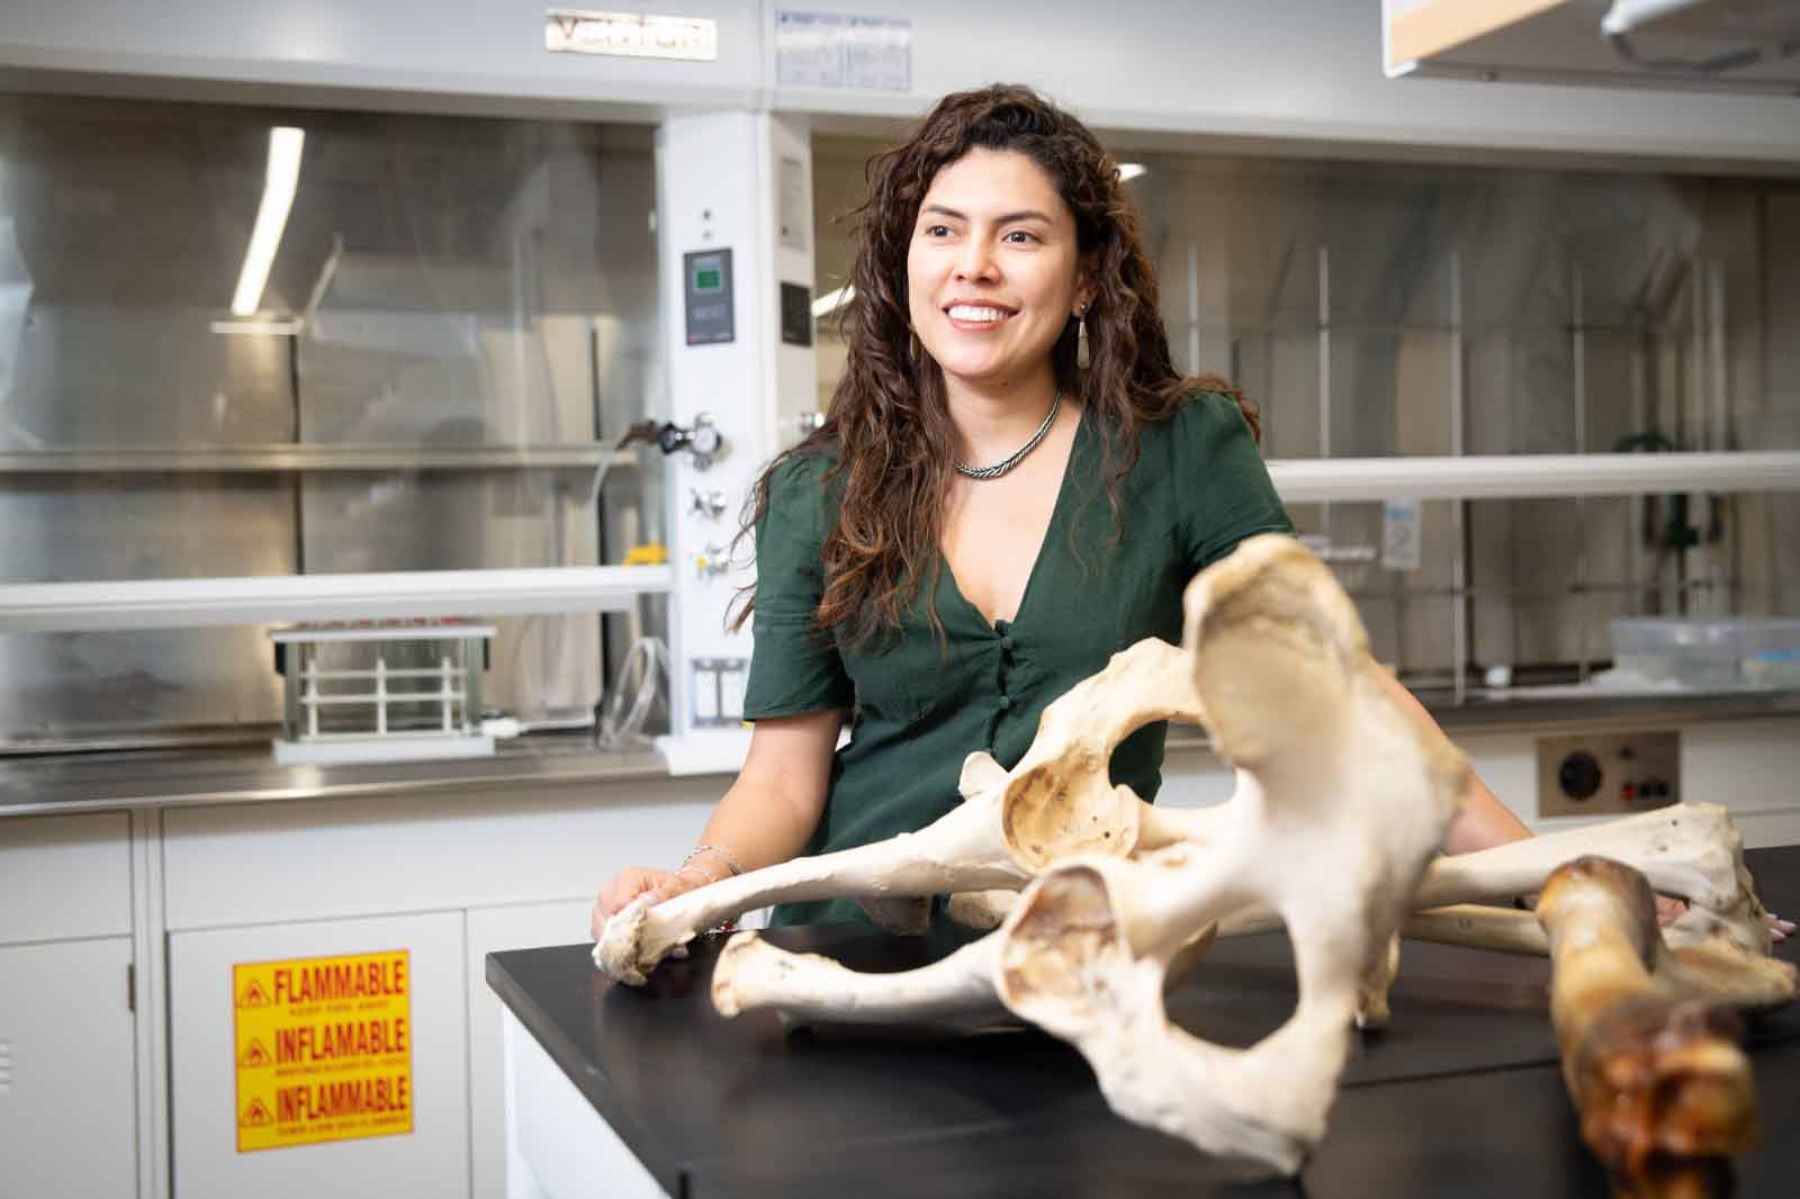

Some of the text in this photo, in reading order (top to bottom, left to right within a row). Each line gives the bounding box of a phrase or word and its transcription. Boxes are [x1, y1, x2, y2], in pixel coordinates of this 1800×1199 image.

[274, 959, 404, 1006] FLAMMABLE
[275, 1018, 406, 1065] INFLAMABLE
[276, 1075, 408, 1123] INFLAMMABLE
